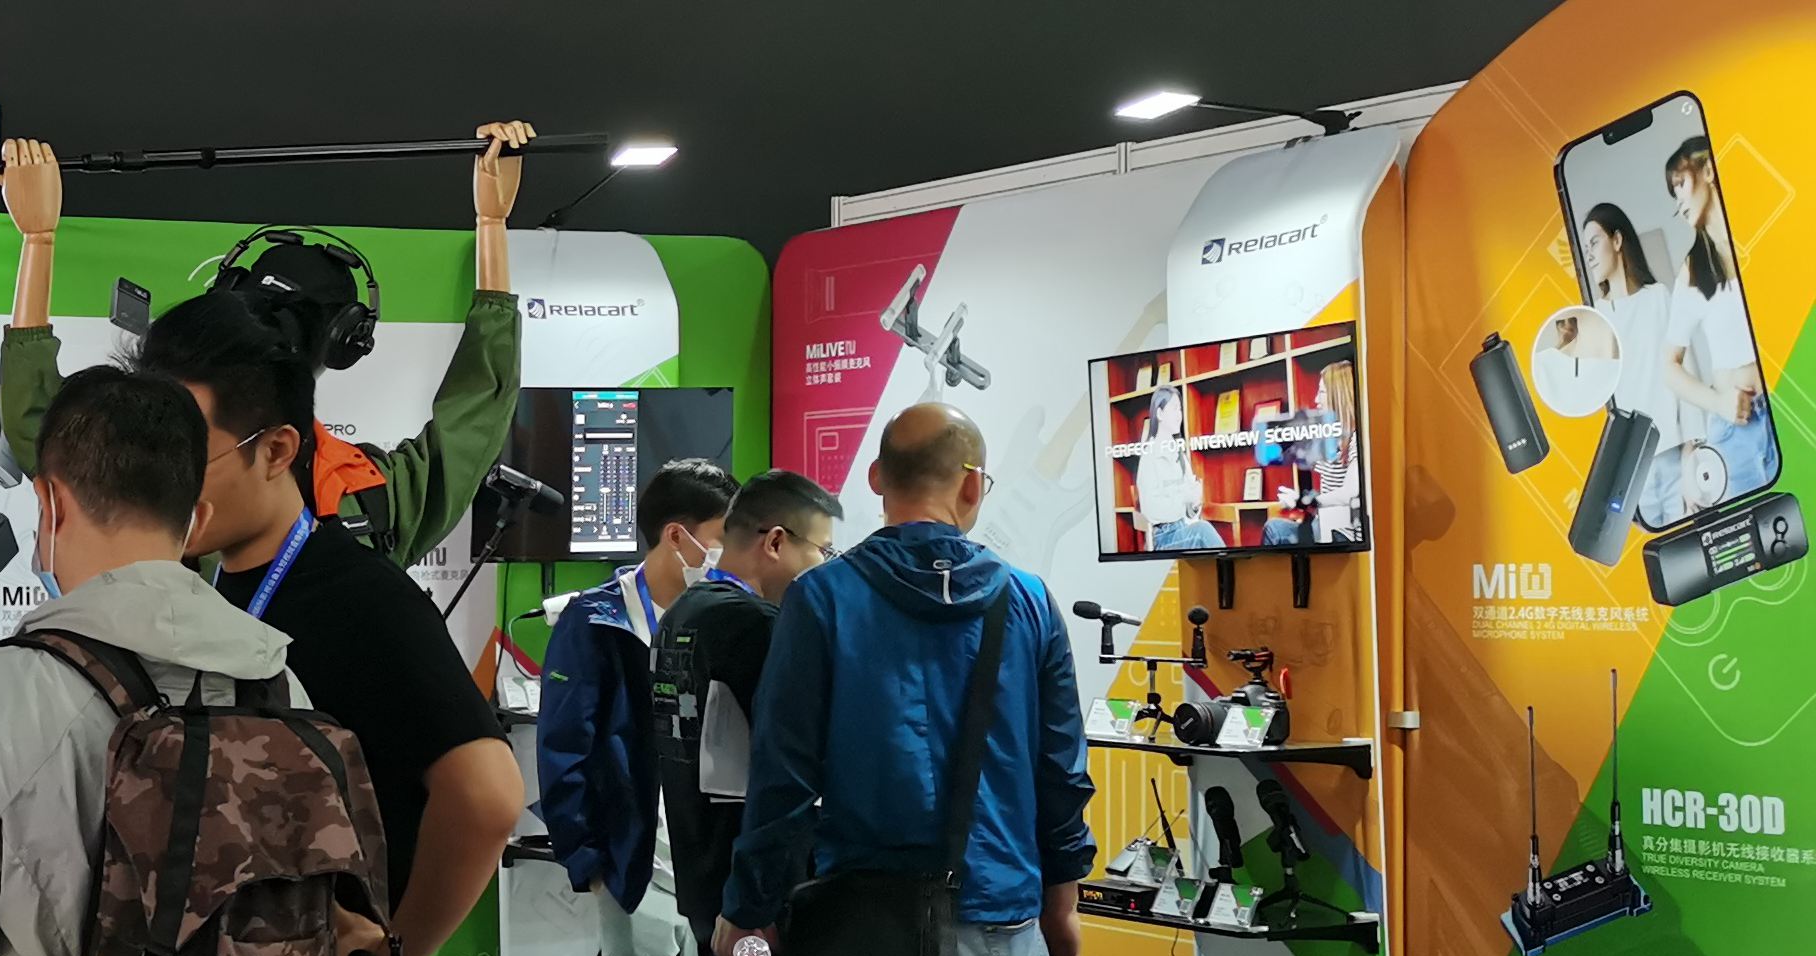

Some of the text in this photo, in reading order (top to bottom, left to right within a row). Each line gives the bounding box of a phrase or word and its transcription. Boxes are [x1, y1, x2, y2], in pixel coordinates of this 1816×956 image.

[1188, 431, 1260, 452] INTERVIEW
[1264, 422, 1344, 445] SCENARIOS
[1641, 787, 1786, 836] HCR-30D
[1641, 852, 1765, 873] TRUE DIVERSITY CAMERA
[1641, 865, 1787, 888] WIRELESS RECEIVER SYSTEM
